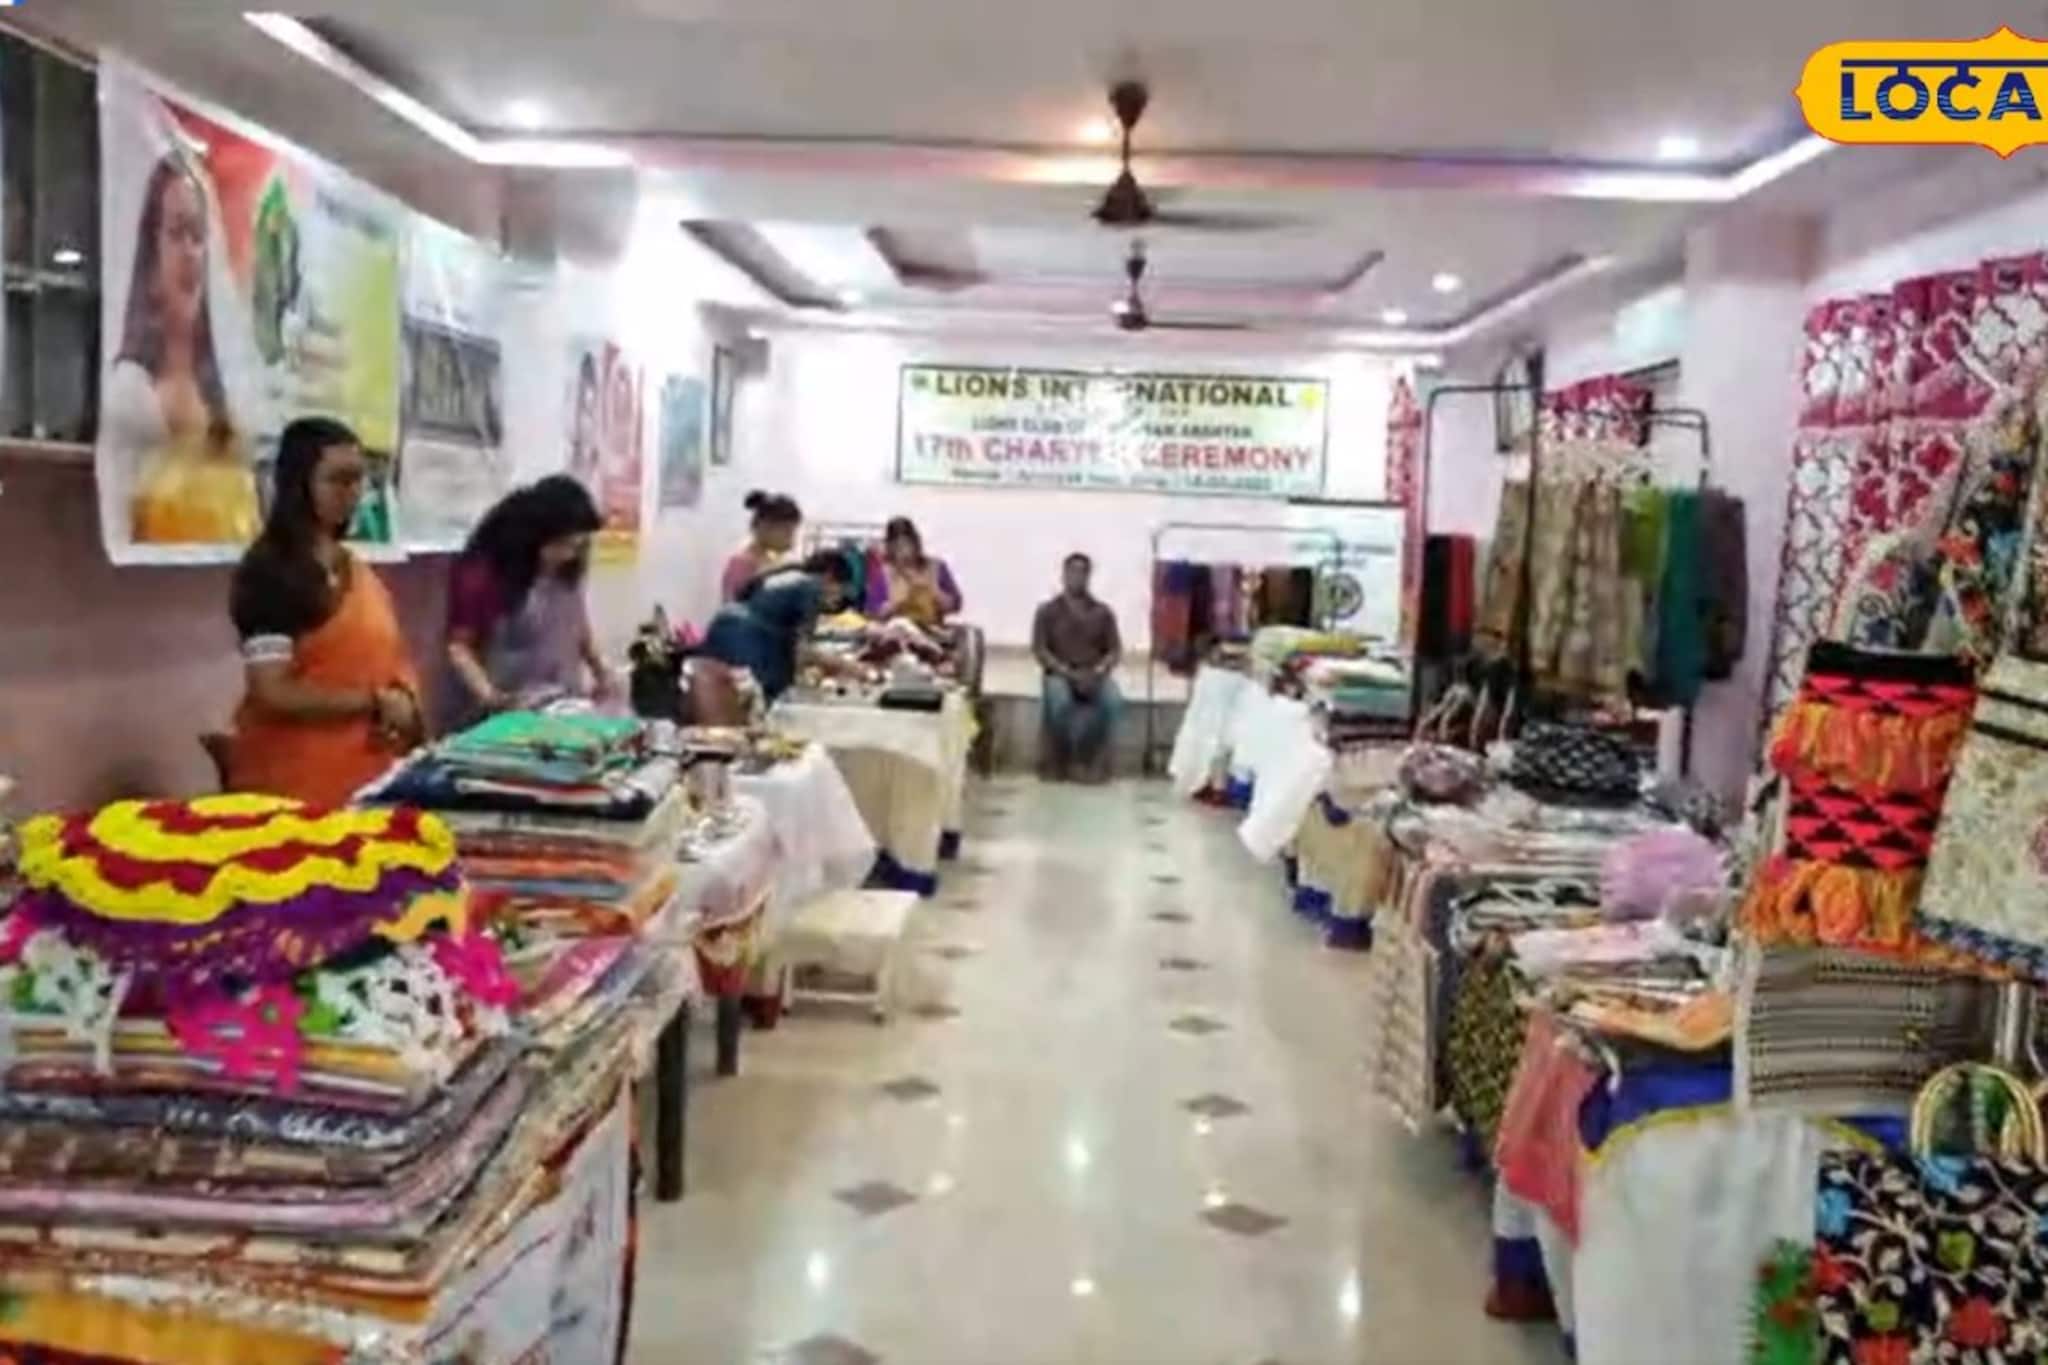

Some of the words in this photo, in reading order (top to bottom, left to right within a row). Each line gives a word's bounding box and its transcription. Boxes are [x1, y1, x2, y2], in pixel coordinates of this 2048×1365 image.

[936, 373, 1029, 399] LIONS
[1040, 378, 1293, 407] INTNATIONAL
[914, 435, 973, 460] 17th
[983, 436, 1121, 465] CHART
